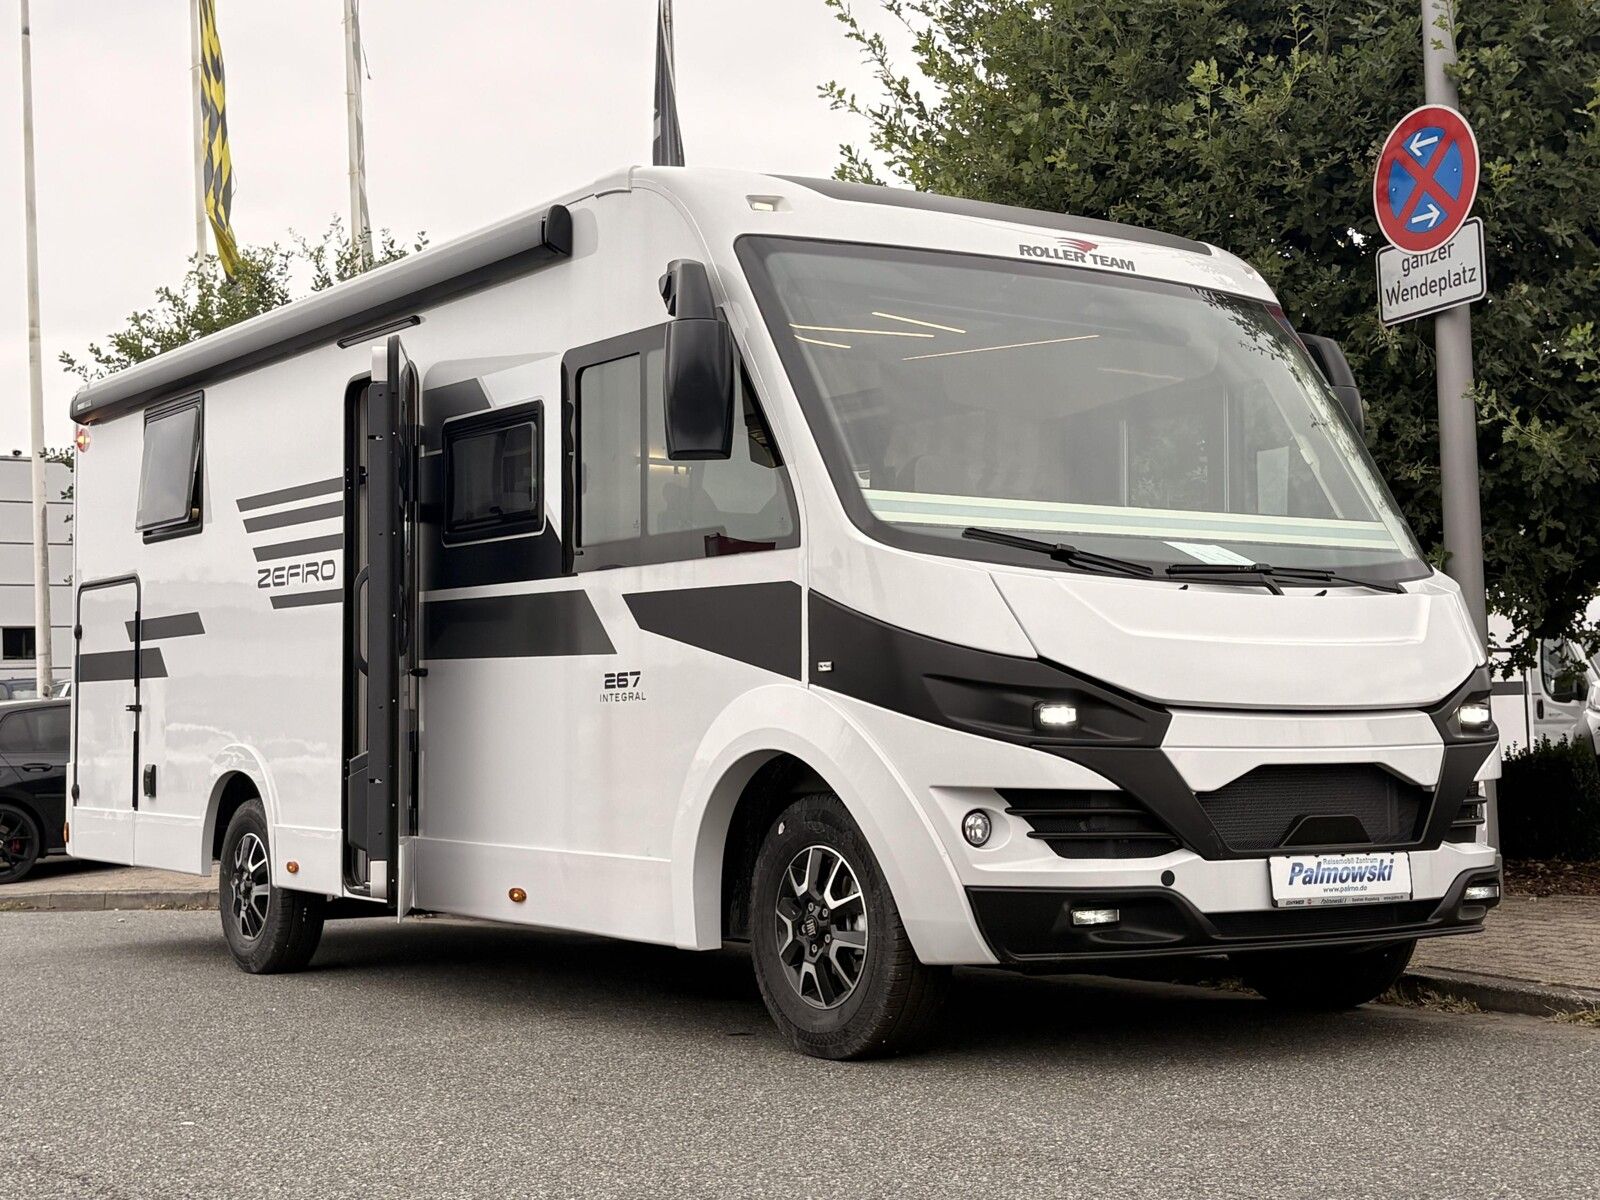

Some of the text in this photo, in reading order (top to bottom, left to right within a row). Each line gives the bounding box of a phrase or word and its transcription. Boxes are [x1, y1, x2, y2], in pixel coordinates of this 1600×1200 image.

[1018, 244, 1136, 272] ROLLER TEAM
[1401, 242, 1455, 277] ganzer
[1385, 266, 1477, 307] Wendeplatz
[257, 559, 336, 589] ZEFIRO
[604, 670, 641, 689] 267
[599, 691, 647, 703] INTEGRAL
[1288, 858, 1395, 886] Palmowski
[1322, 885, 1368, 894] www.palmo.de
